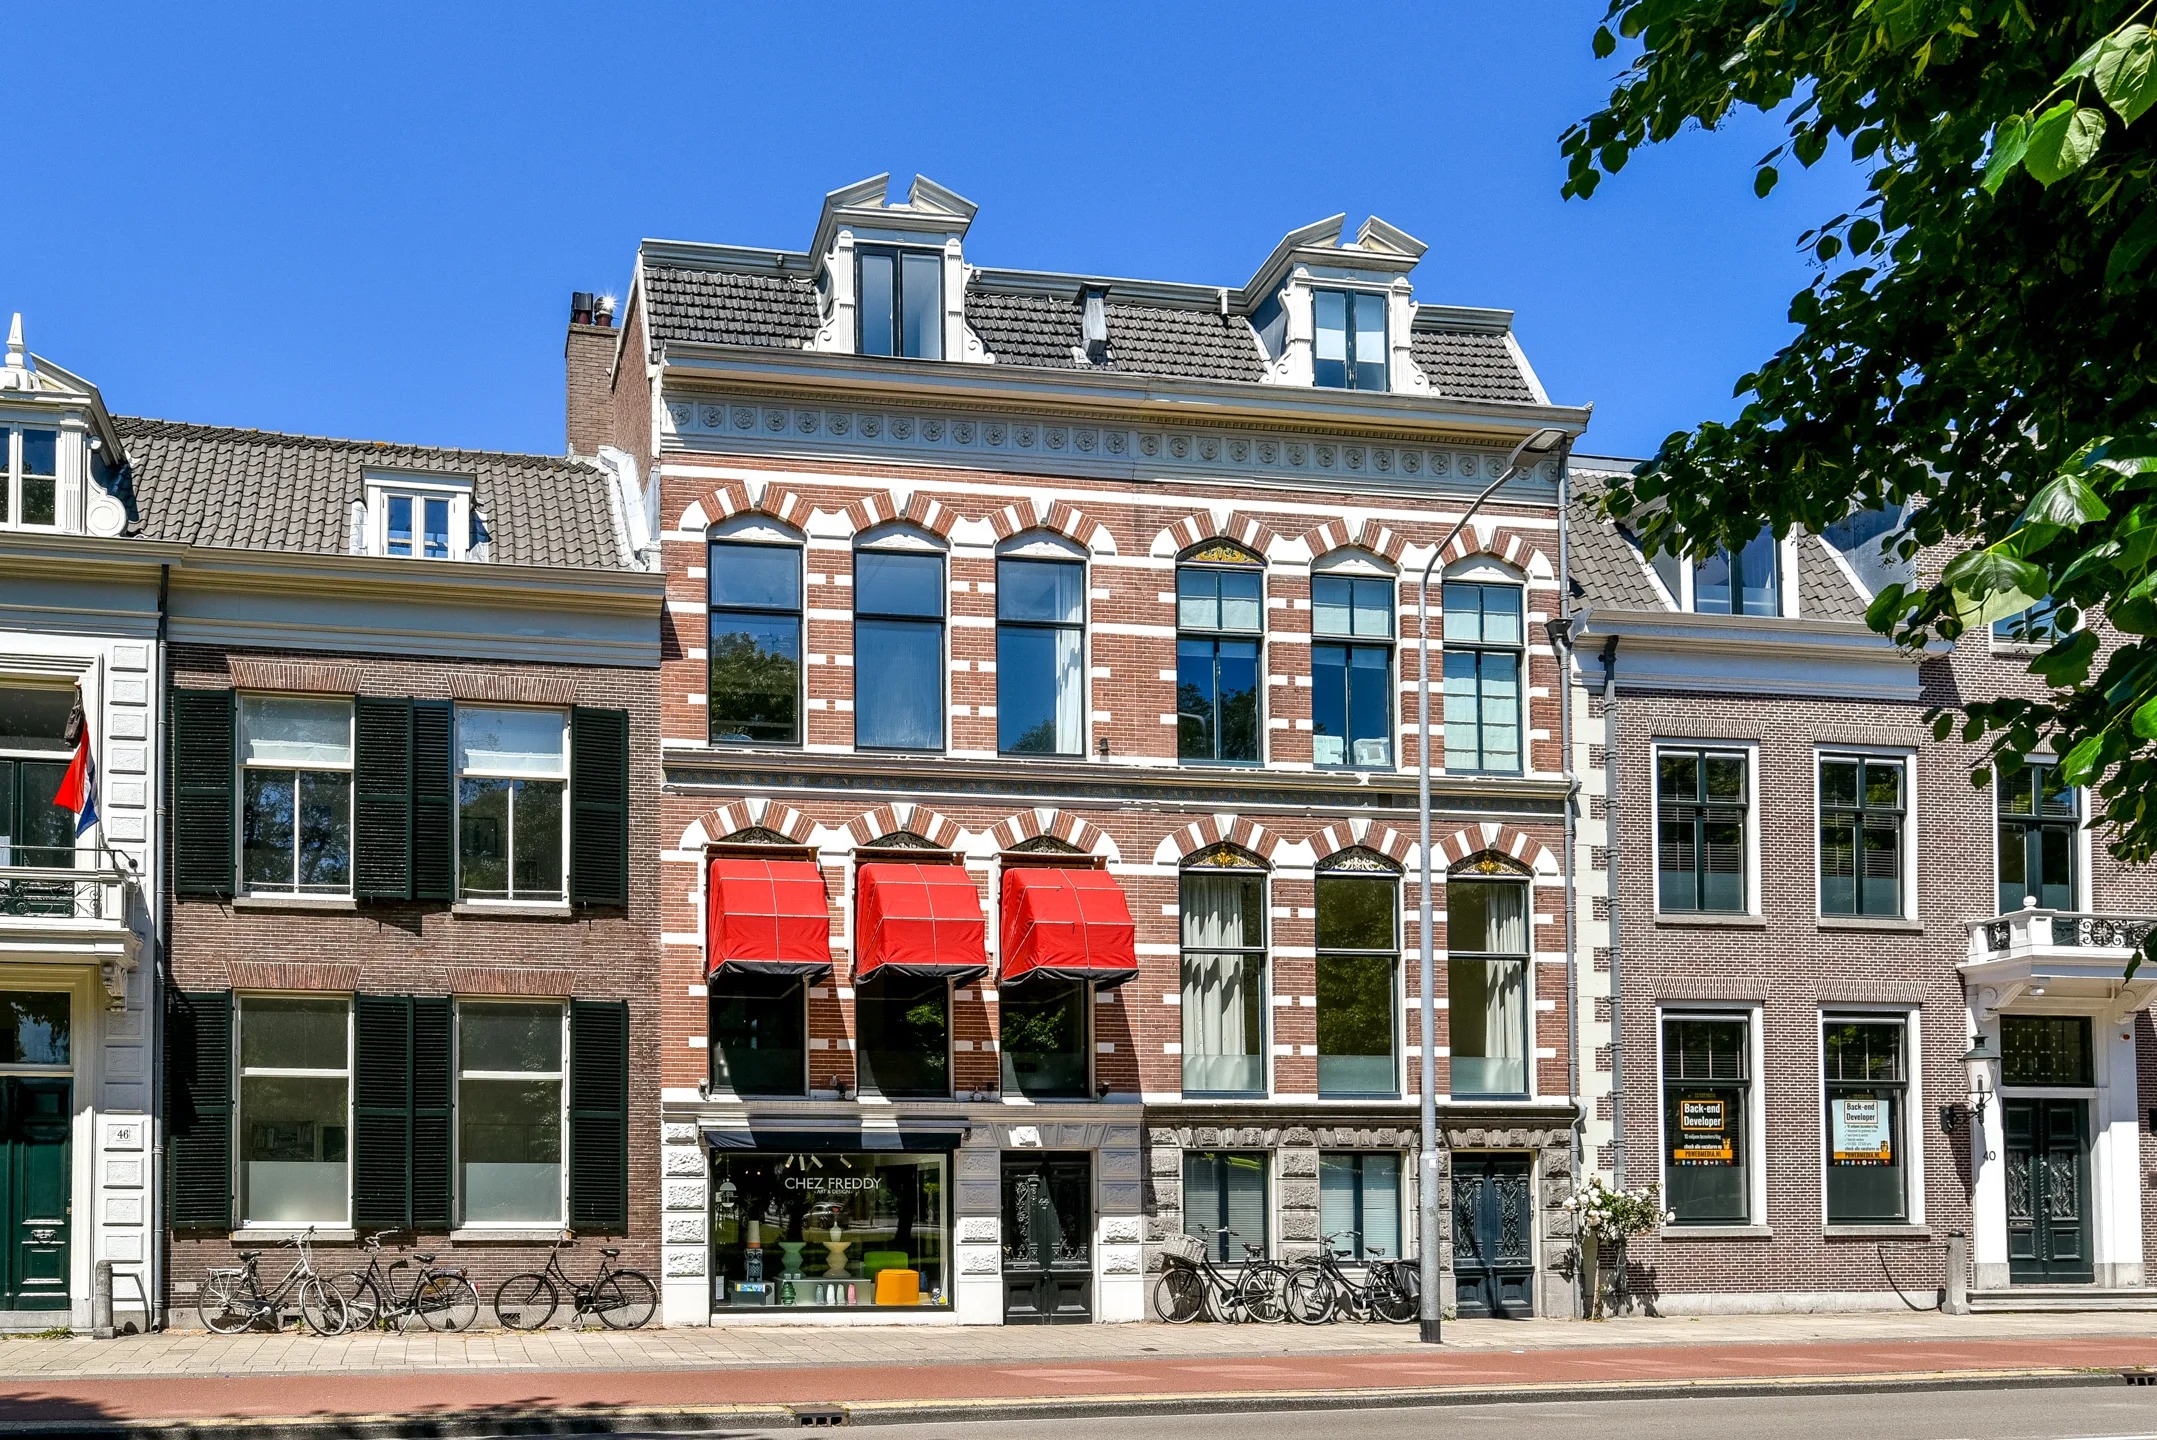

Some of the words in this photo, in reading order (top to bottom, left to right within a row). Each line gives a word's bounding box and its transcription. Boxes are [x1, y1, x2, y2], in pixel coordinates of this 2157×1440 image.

[1684, 1103, 1720, 1114] Back-end
[1846, 1102, 1874, 1110] Back-end
[1684, 1116, 1721, 1128] Developer
[1846, 1112, 1875, 1121] Developer
[117, 1129, 129, 1140] 46
[1982, 1150, 1996, 1162] 40
[784, 1177, 824, 1189] CHEZ
[828, 1177, 882, 1189] FREDDY
